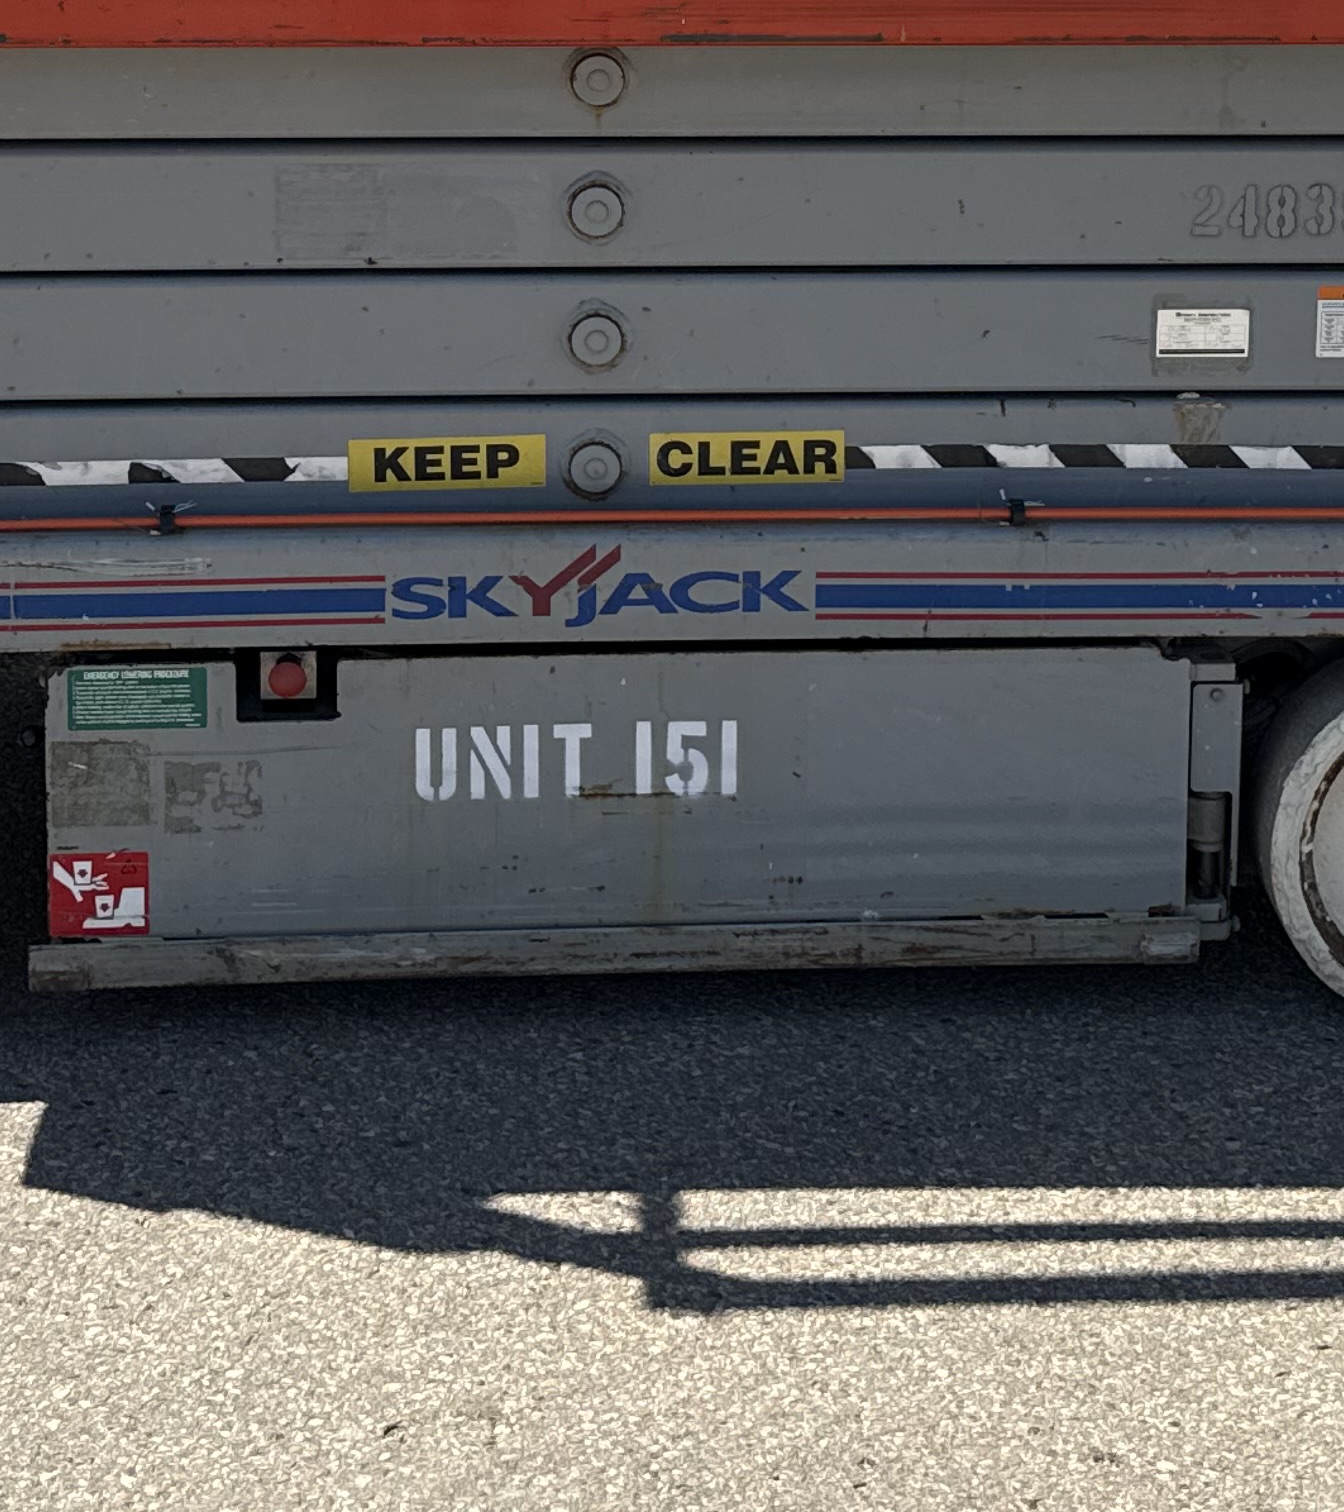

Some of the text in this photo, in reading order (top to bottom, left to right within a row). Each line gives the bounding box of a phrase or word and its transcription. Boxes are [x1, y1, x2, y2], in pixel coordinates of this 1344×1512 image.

[373, 440, 839, 483] KEEP CLEAR
[391, 544, 810, 627] SKYJACK
[415, 720, 738, 801] UNIT 151
